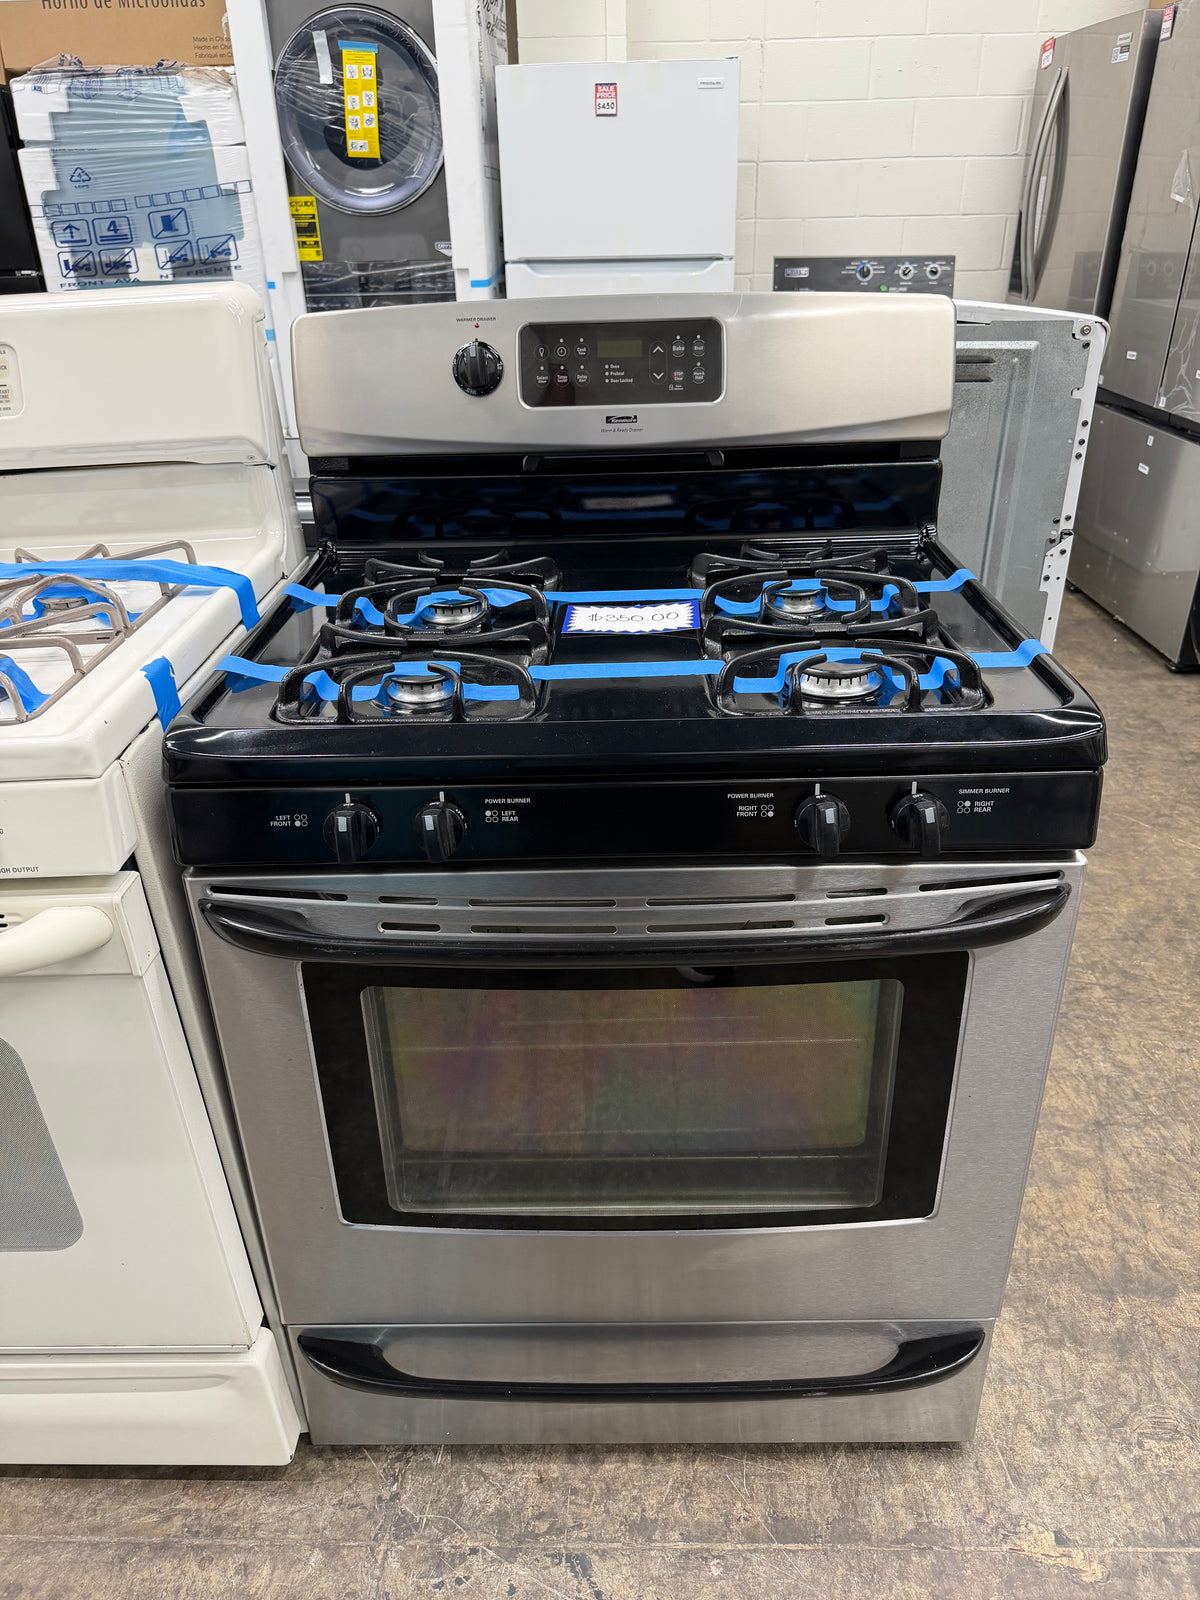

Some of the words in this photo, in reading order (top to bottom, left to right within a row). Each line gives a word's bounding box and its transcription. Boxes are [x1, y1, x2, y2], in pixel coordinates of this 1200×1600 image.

[94, 0, 112, 9] de
[119, 0, 206, 9] Microondas
[597, 102, 615, 110] $450
[106, 220, 120, 234] 4
[60, 279, 105, 289] FRONT
[588, 612, 679, 622] $350.00
